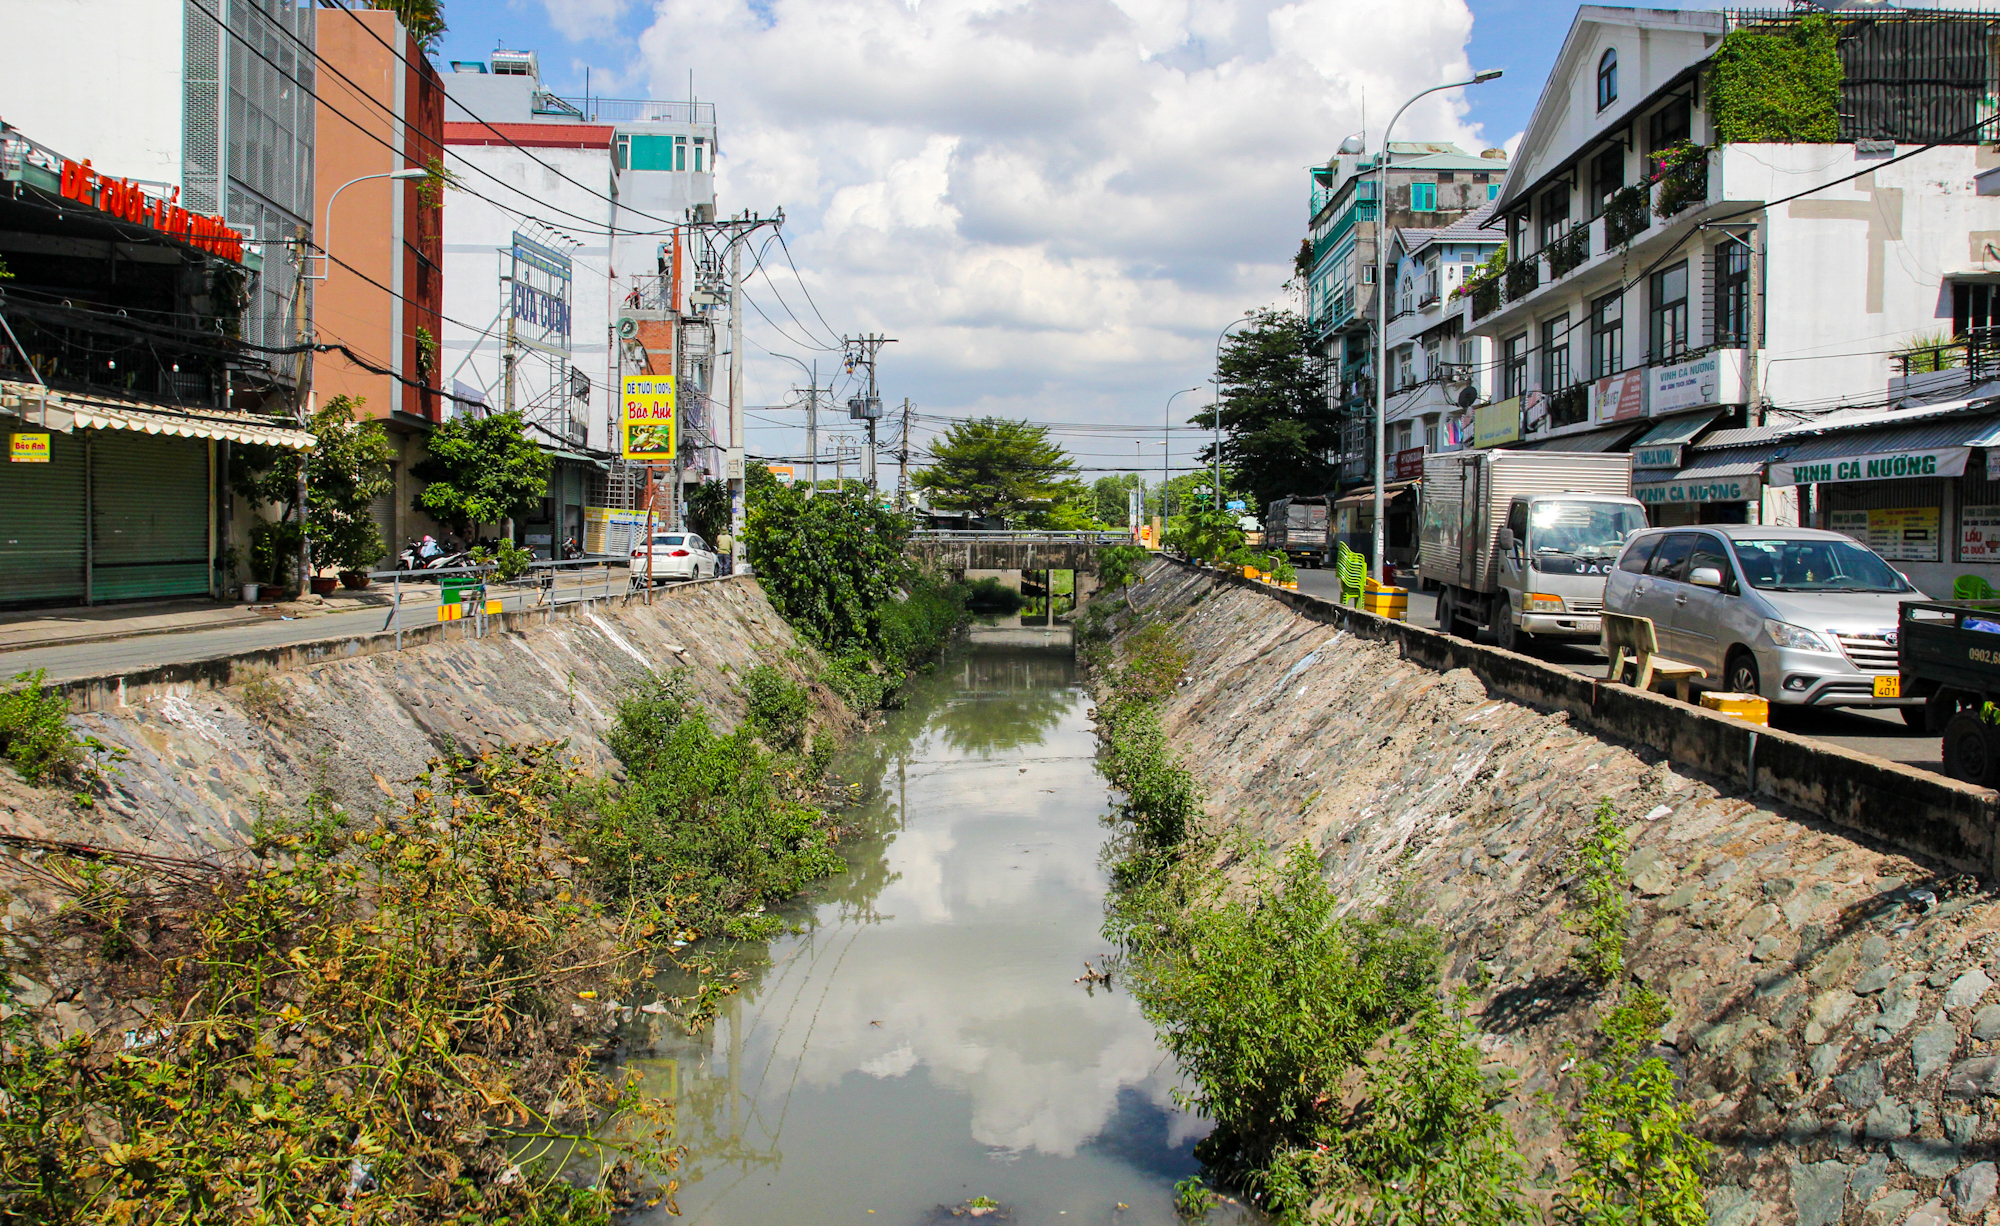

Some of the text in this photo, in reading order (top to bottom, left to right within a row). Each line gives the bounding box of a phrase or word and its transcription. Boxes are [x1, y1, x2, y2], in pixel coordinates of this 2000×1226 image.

[61, 158, 95, 206] DÊ
[1660, 370, 1677, 382] VINH
[627, 380, 636, 394] DÊ
[654, 382, 672, 395] 100%
[627, 401, 672, 420] Bảo Anh
[32, 442, 46, 450] Anh
[1793, 454, 1937, 483] VINH CÁ NƯỚNG
[1635, 487, 1666, 502] VINH
[1575, 564, 1613, 574] JAC
